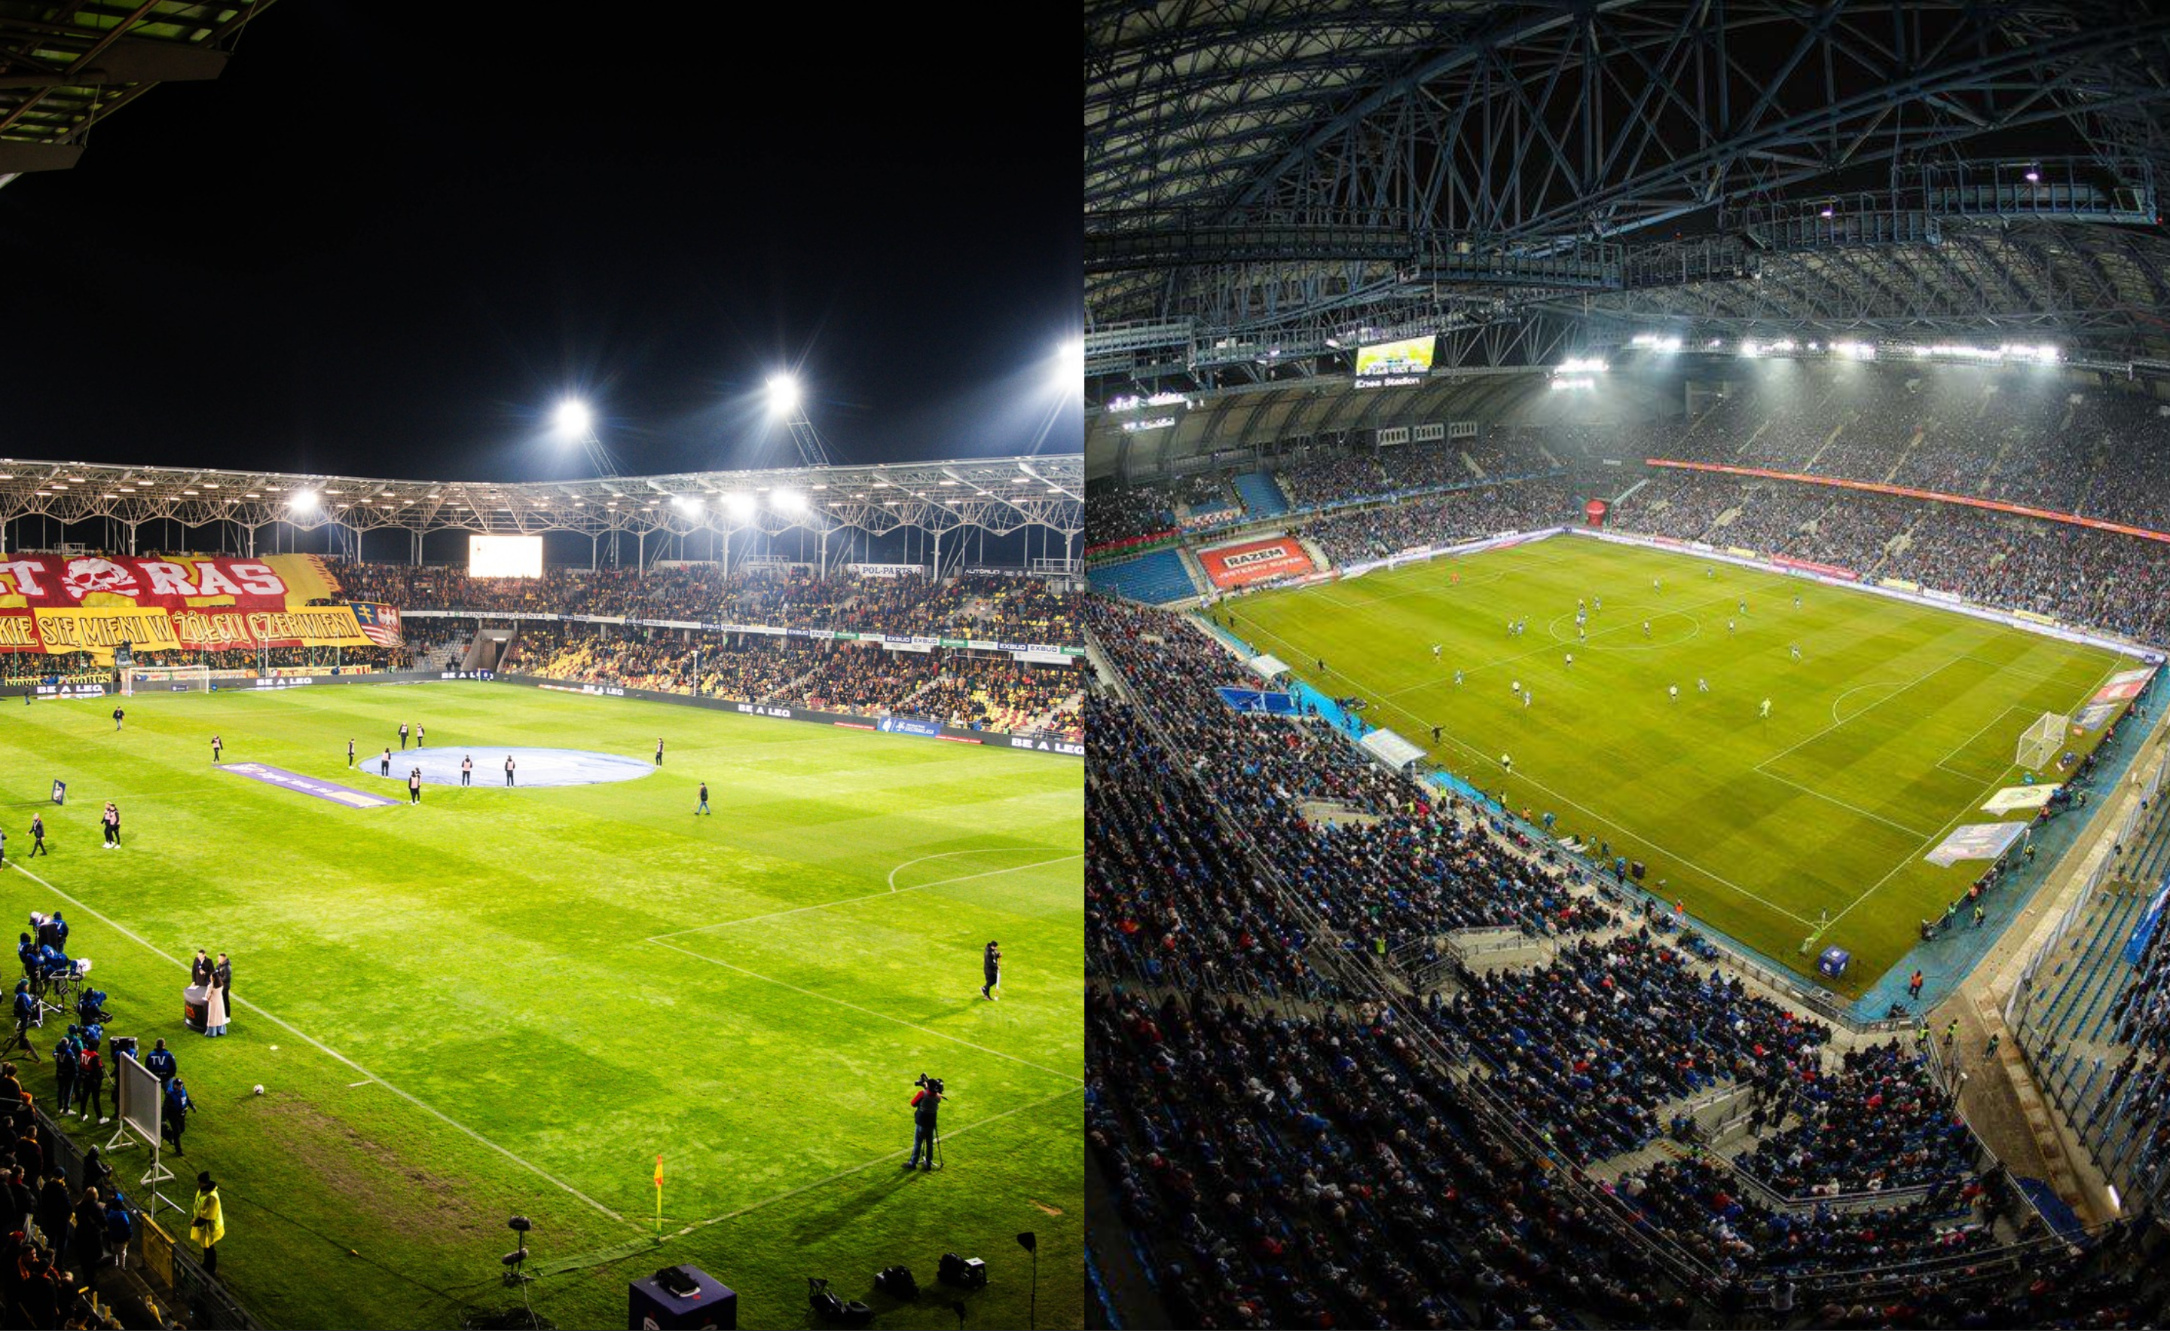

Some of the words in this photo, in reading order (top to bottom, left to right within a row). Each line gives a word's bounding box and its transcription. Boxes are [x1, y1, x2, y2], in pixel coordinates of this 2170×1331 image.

[1226, 548, 1283, 566] RAZEM
[862, 566, 912, 575] POL-PARTS
[137, 561, 285, 596] RAS
[247, 612, 360, 641] CZERWIENI
[256, 678, 273, 686] BE
[36, 686, 57, 694] BE
[61, 685, 71, 693] A
[738, 703, 753, 713] BE
[756, 706, 765, 714] A
[1011, 737, 1033, 749] BE
[1037, 741, 1050, 751] A
[81, 1053, 91, 1066] TV
[151, 1055, 166, 1066] TV
